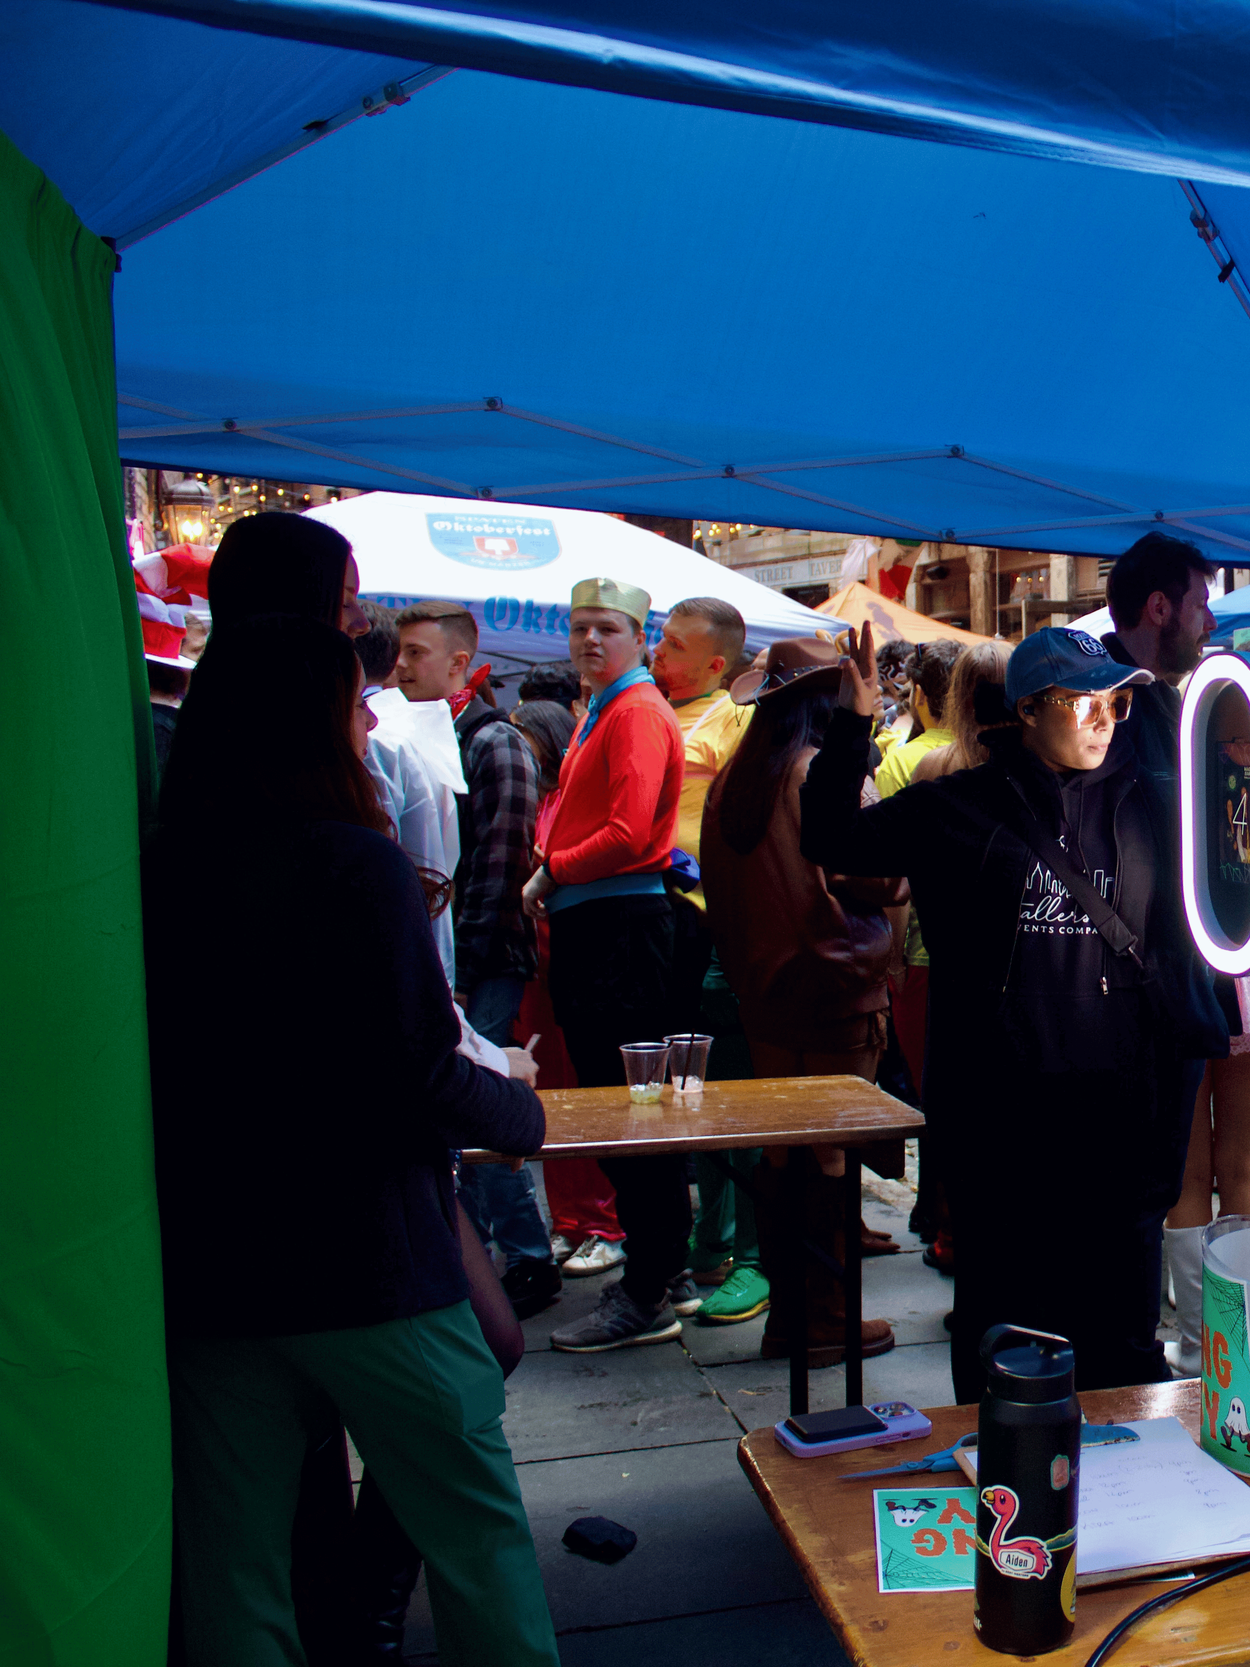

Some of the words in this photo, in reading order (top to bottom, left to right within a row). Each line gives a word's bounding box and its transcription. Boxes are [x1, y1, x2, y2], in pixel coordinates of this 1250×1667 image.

[432, 520, 552, 536] Oktoberfest
[754, 565, 794, 582] STREET
[809, 559, 842, 577] TAVER
[1082, 639, 1104, 653] 66
[1058, 926, 1099, 935] COMPA
[1005, 1553, 1028, 1568] Aiden
